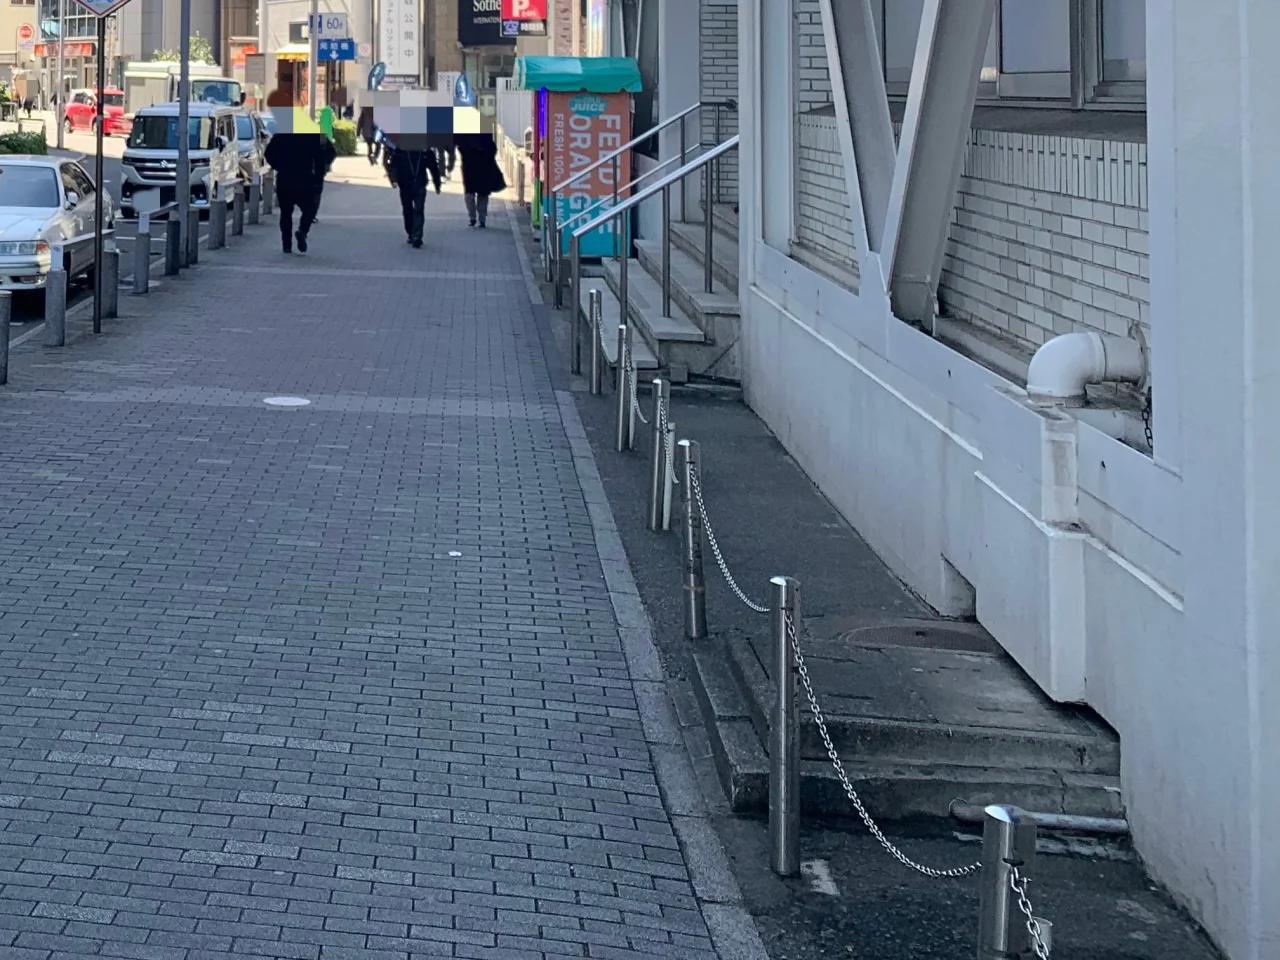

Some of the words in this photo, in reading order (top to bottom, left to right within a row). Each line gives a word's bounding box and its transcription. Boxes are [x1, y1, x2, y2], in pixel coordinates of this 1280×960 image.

[571, 103, 605, 112] JUICE
[554, 113, 564, 152] FRESH
[598, 114, 621, 185] FEED
